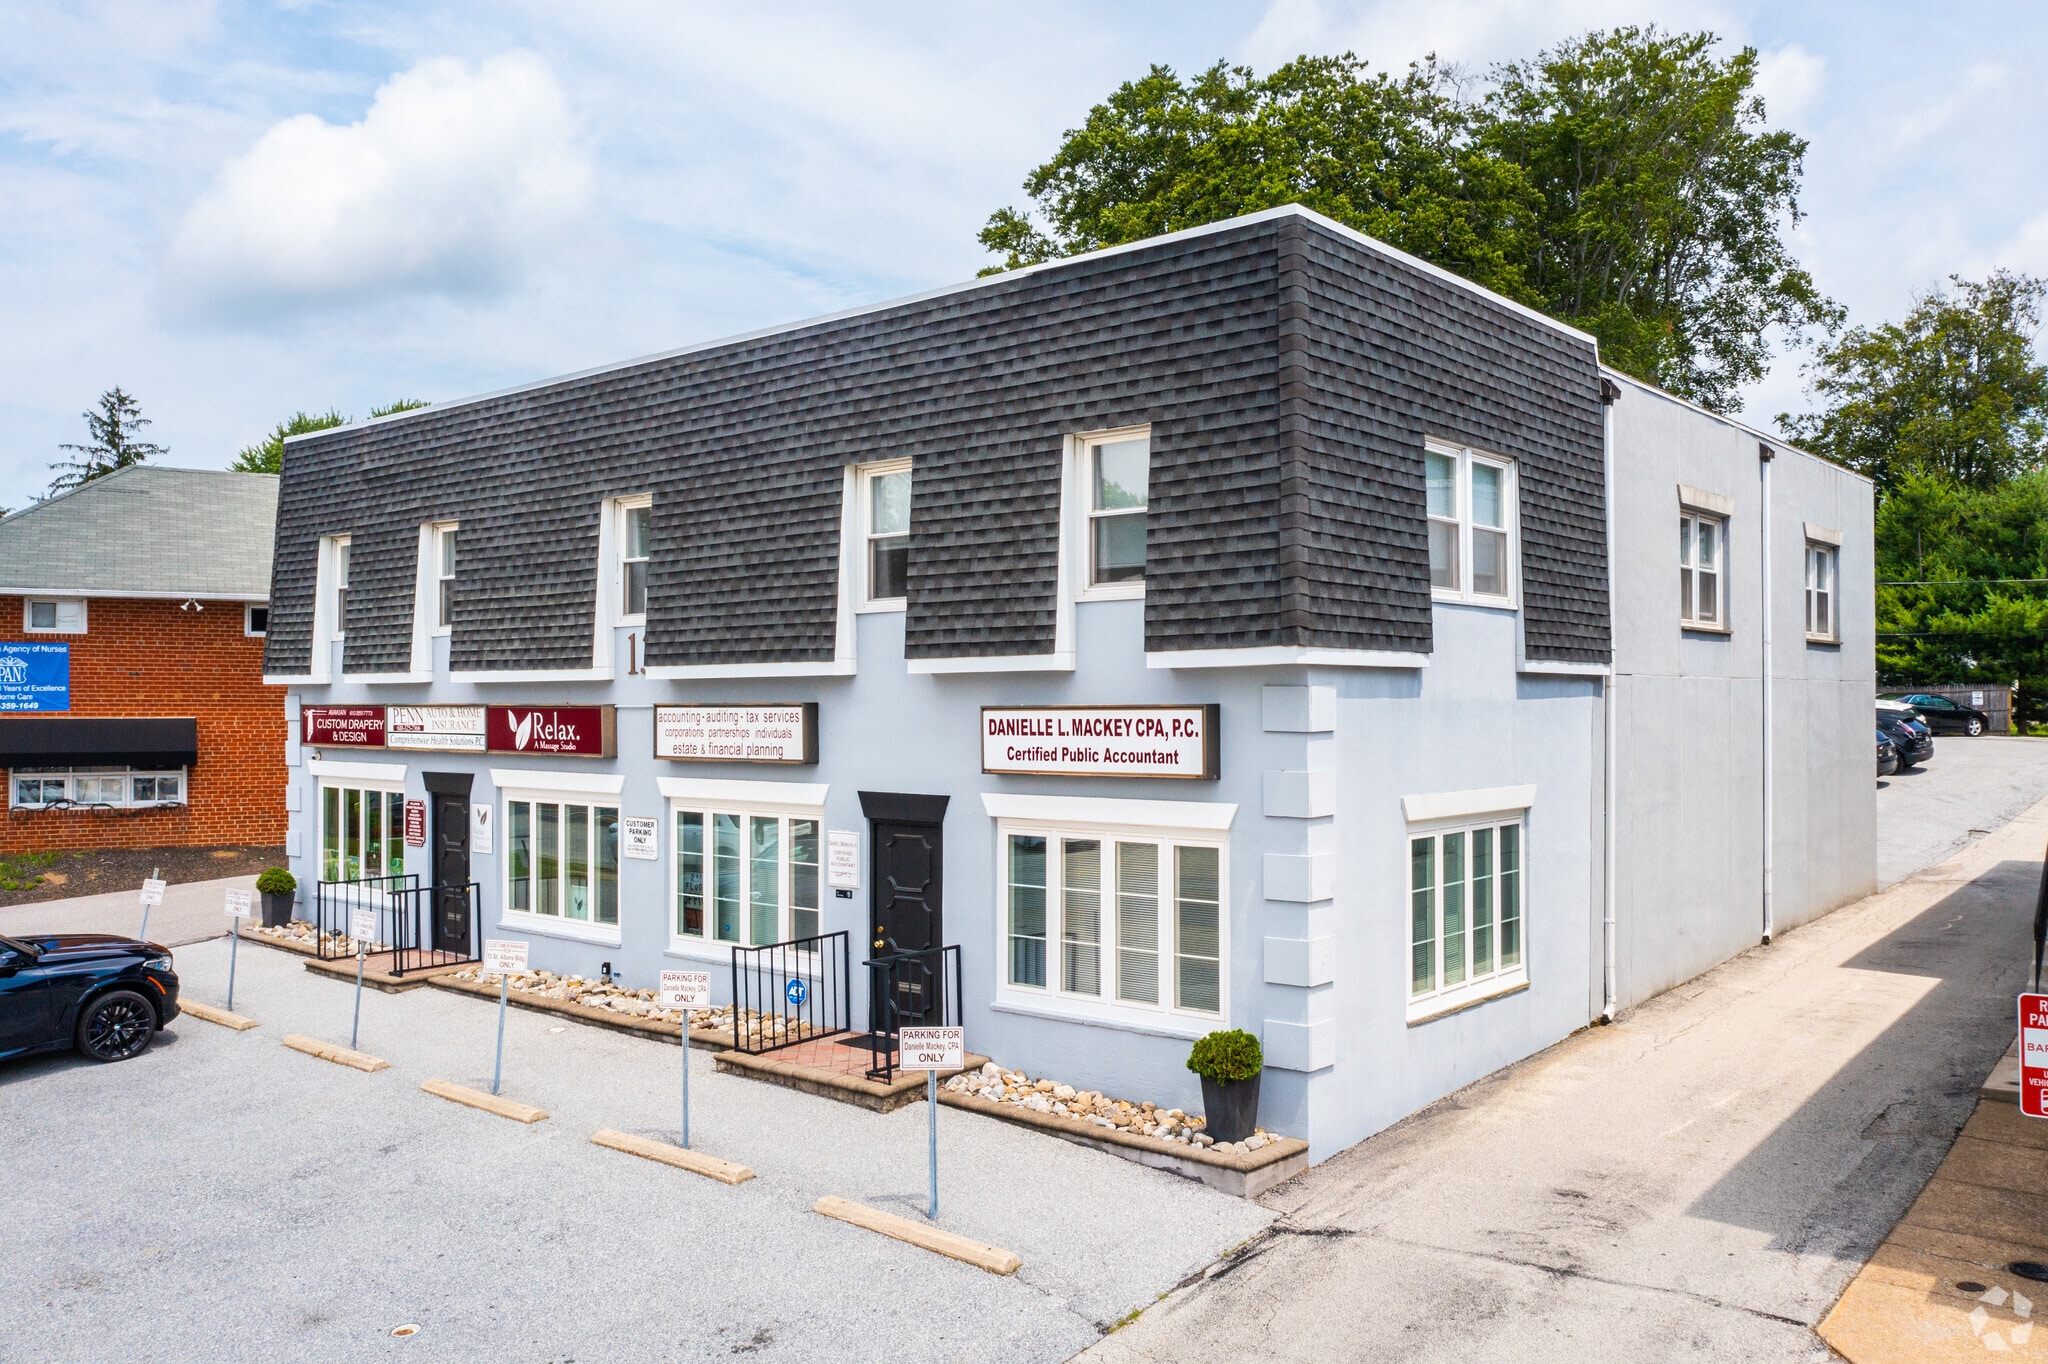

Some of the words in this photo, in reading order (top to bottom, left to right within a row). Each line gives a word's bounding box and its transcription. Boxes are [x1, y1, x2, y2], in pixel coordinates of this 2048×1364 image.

[3, 645, 30, 654] Agency
[393, 707, 424, 723] PENN
[427, 707, 447, 717] AUTO
[449, 708, 455, 718] &
[457, 707, 481, 718] HOME
[658, 709, 700, 725] accounting
[706, 709, 739, 725] auditing
[746, 711, 759, 722] tax
[763, 711, 799, 723] services
[317, 719, 347, 729] CUSTOM
[348, 719, 384, 730] DRAPERY
[432, 720, 477, 730] INSURANCE
[533, 711, 580, 740] Relax.
[988, 718, 1053, 736] DANIELLE
[1058, 718, 1069, 736] L.
[1072, 718, 1136, 737] MACKEY
[1136, 718, 1168, 741] CPA,
[1172, 718, 1199, 737] P.C.
[332, 731, 338, 741] &
[339, 731, 367, 742] DESIGN
[665, 727, 704, 739] corporations
[708, 727, 750, 740] partnerships
[755, 727, 792, 738] individuals
[390, 735, 428, 745] Comprehensive
[430, 736, 448, 745] Health
[449, 736, 473, 746] Solutions
[534, 741, 539, 749] A
[540, 741, 559, 752] Massage
[560, 741, 576, 750] Studio
[673, 743, 697, 754] estate
[700, 745, 705, 754] &
[709, 743, 743, 755] financial
[747, 743, 784, 759] planning
[1007, 746, 1057, 762] Certified
[1062, 746, 1099, 762] Public
[1103, 747, 1179, 765] Accountant
[626, 820, 655, 828] CUSTOMER
[629, 828, 651, 836] PARKING
[663, 974, 692, 982] PARKING
[674, 994, 695, 1002] ONLY
[2030, 1013, 2048, 1026] PA
[903, 1031, 940, 1039] PARKING
[943, 1031, 960, 1039] FOR
[904, 1042, 924, 1050] Danielle
[947, 1042, 959, 1050] CPA
[918, 1053, 945, 1062] ONLY
[2029, 1078, 2048, 1087] VEHI
